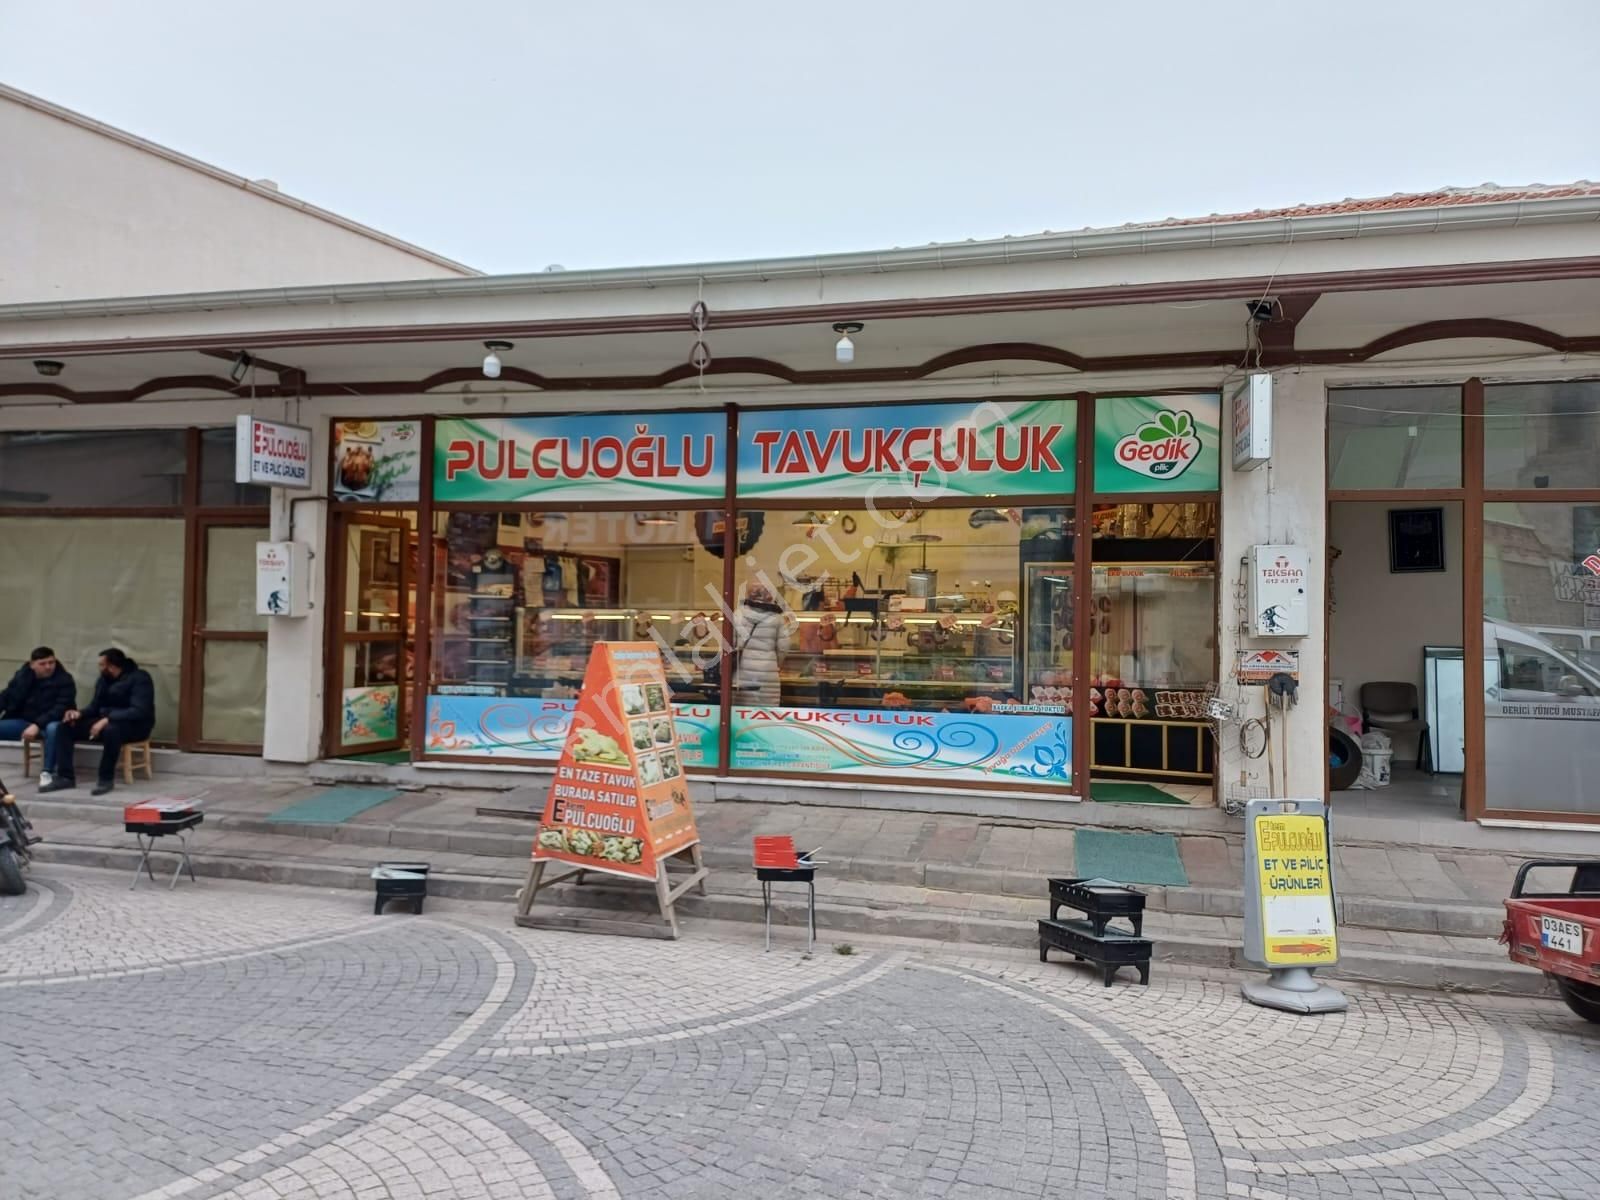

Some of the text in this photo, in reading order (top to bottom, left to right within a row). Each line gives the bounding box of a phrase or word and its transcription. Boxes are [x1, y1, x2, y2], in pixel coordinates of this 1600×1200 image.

[446, 424, 714, 481] PULCUOĞLU
[752, 424, 1064, 488] TAVUKÇULUK
[1119, 438, 1191, 462] Gedik
[735, 709, 935, 727] TAVUKÇULUK
[1502, 704, 1530, 715] DERİCİ
[560, 767, 637, 788] EN TAZE TAVUK
[555, 784, 638, 807] BURADA SATILIR
[563, 809, 635, 834] PULCUOĞLU
[1264, 856, 1325, 873] ET VE PİLİÇ
[1269, 874, 1323, 891] ÜRÜNLERİ
[1550, 935, 1572, 950] 441
